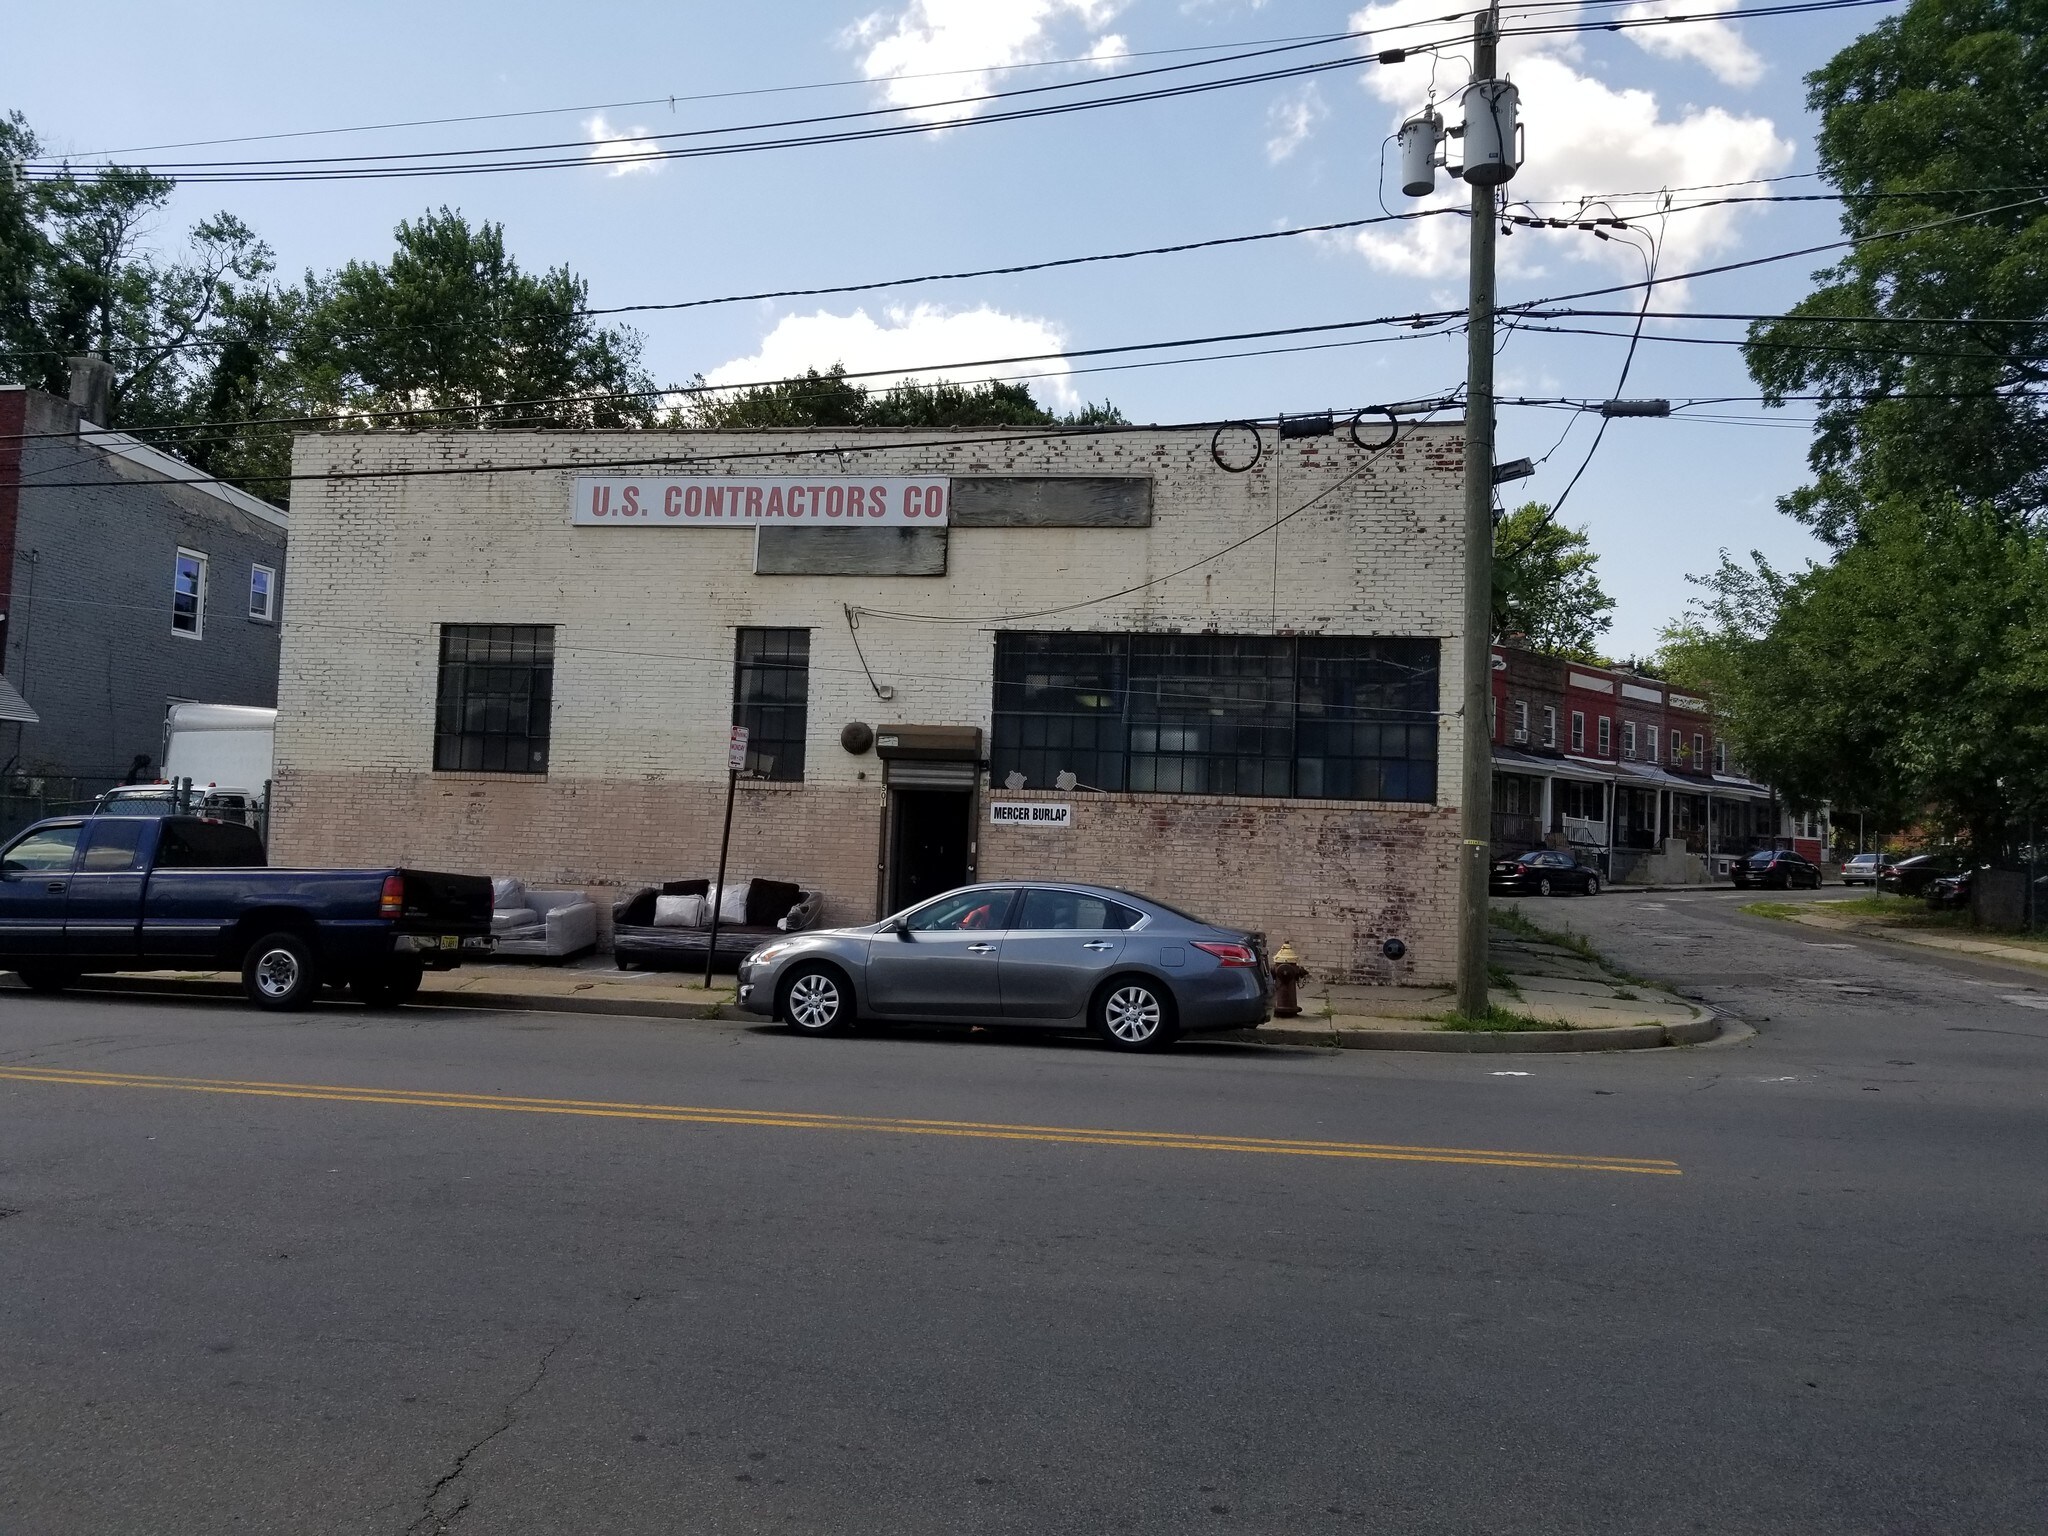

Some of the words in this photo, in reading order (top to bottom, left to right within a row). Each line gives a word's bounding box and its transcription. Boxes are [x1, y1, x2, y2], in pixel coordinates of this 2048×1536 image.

[592, 485, 648, 517] U.S.
[664, 485, 887, 518] CONTRACTORS
[994, 806, 1030, 820] MERCER
[1032, 808, 1067, 822] BURLAP
